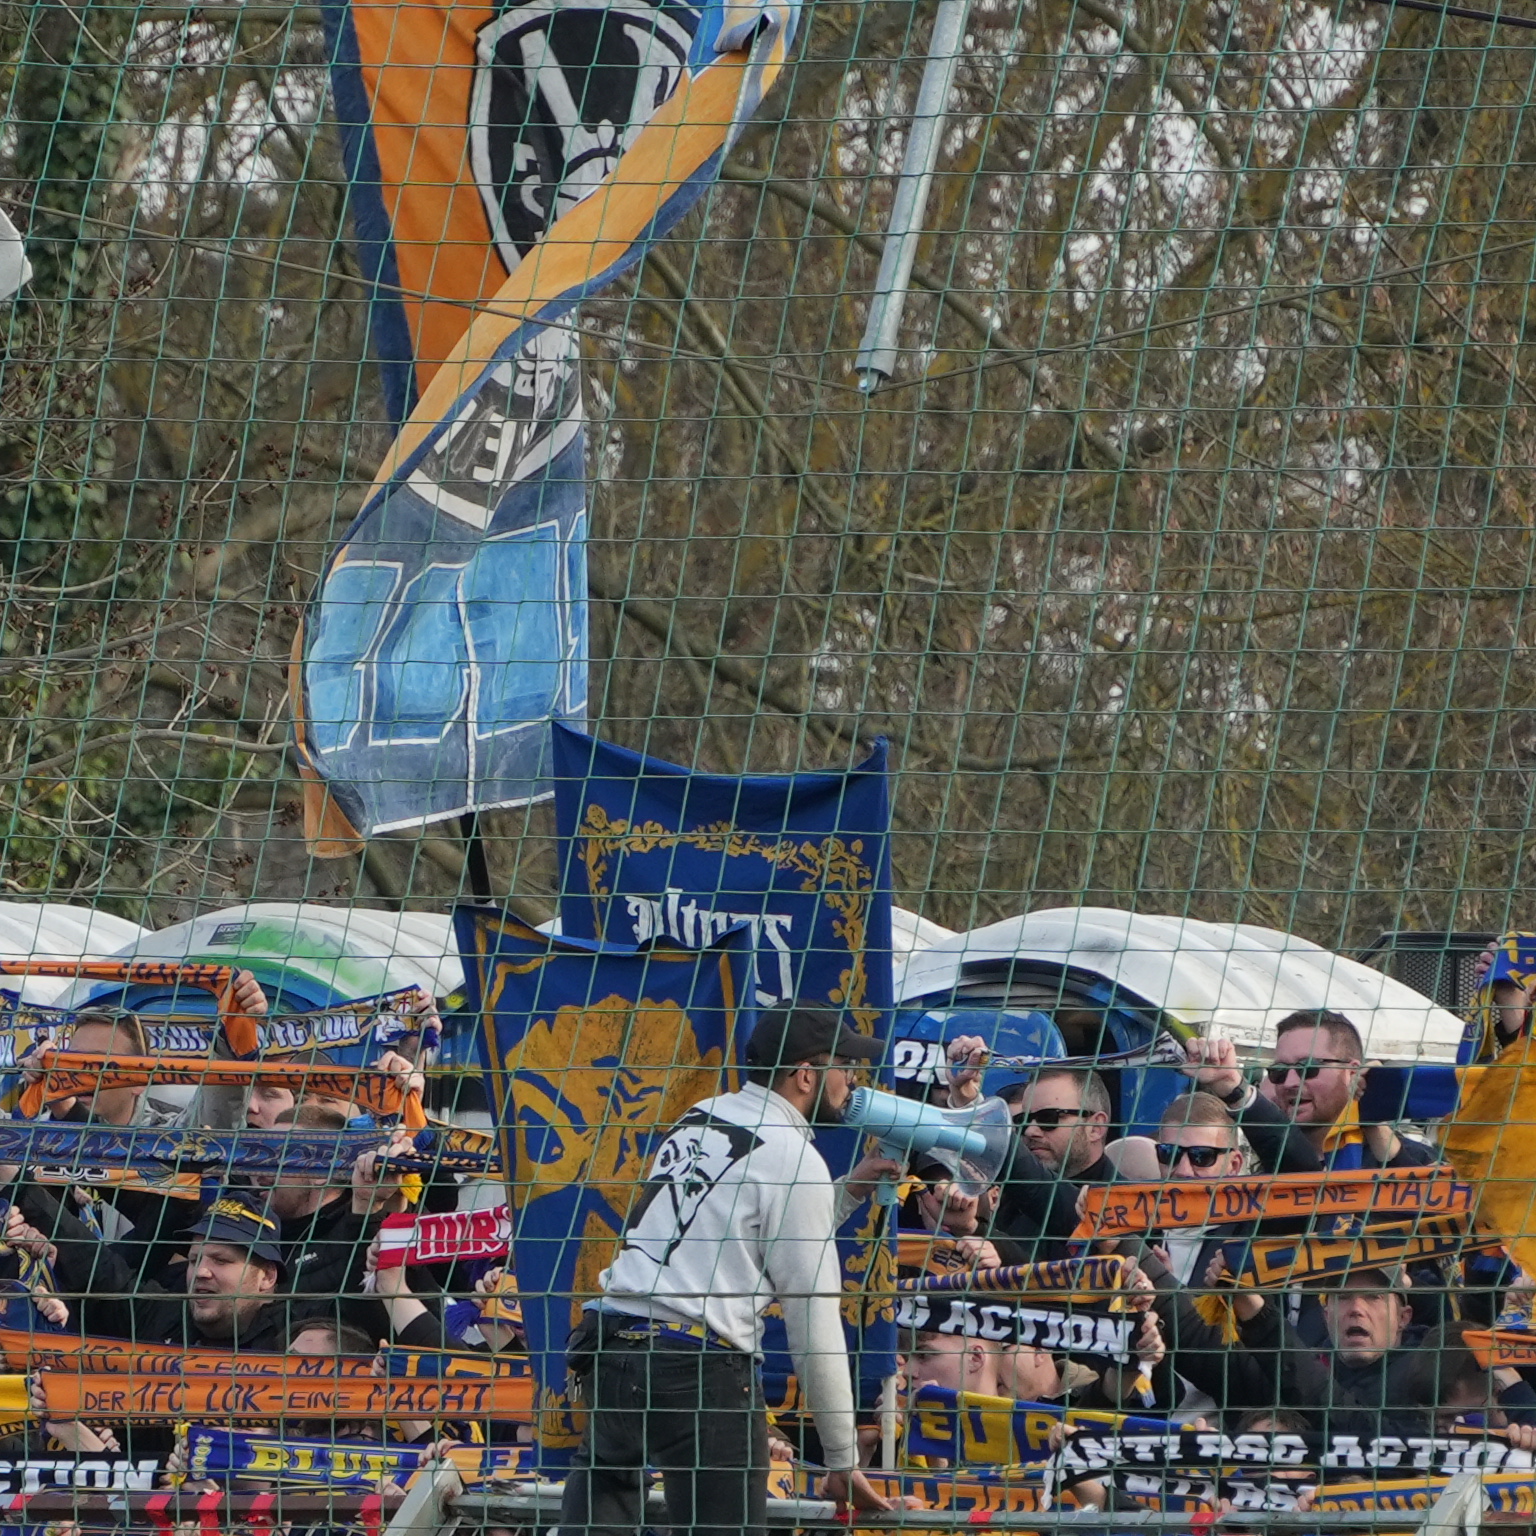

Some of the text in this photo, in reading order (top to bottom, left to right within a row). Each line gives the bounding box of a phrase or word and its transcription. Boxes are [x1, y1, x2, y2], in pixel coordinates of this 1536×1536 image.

[1207, 1181, 1268, 1218] LOK
[1369, 1168, 1473, 1209] MACH
[939, 1301, 1138, 1365] ACTION
[84, 1391, 126, 1411] DER
[204, 1380, 266, 1413] LOK
[287, 1391, 351, 1411] EINE
[363, 1381, 492, 1413] MACHT
